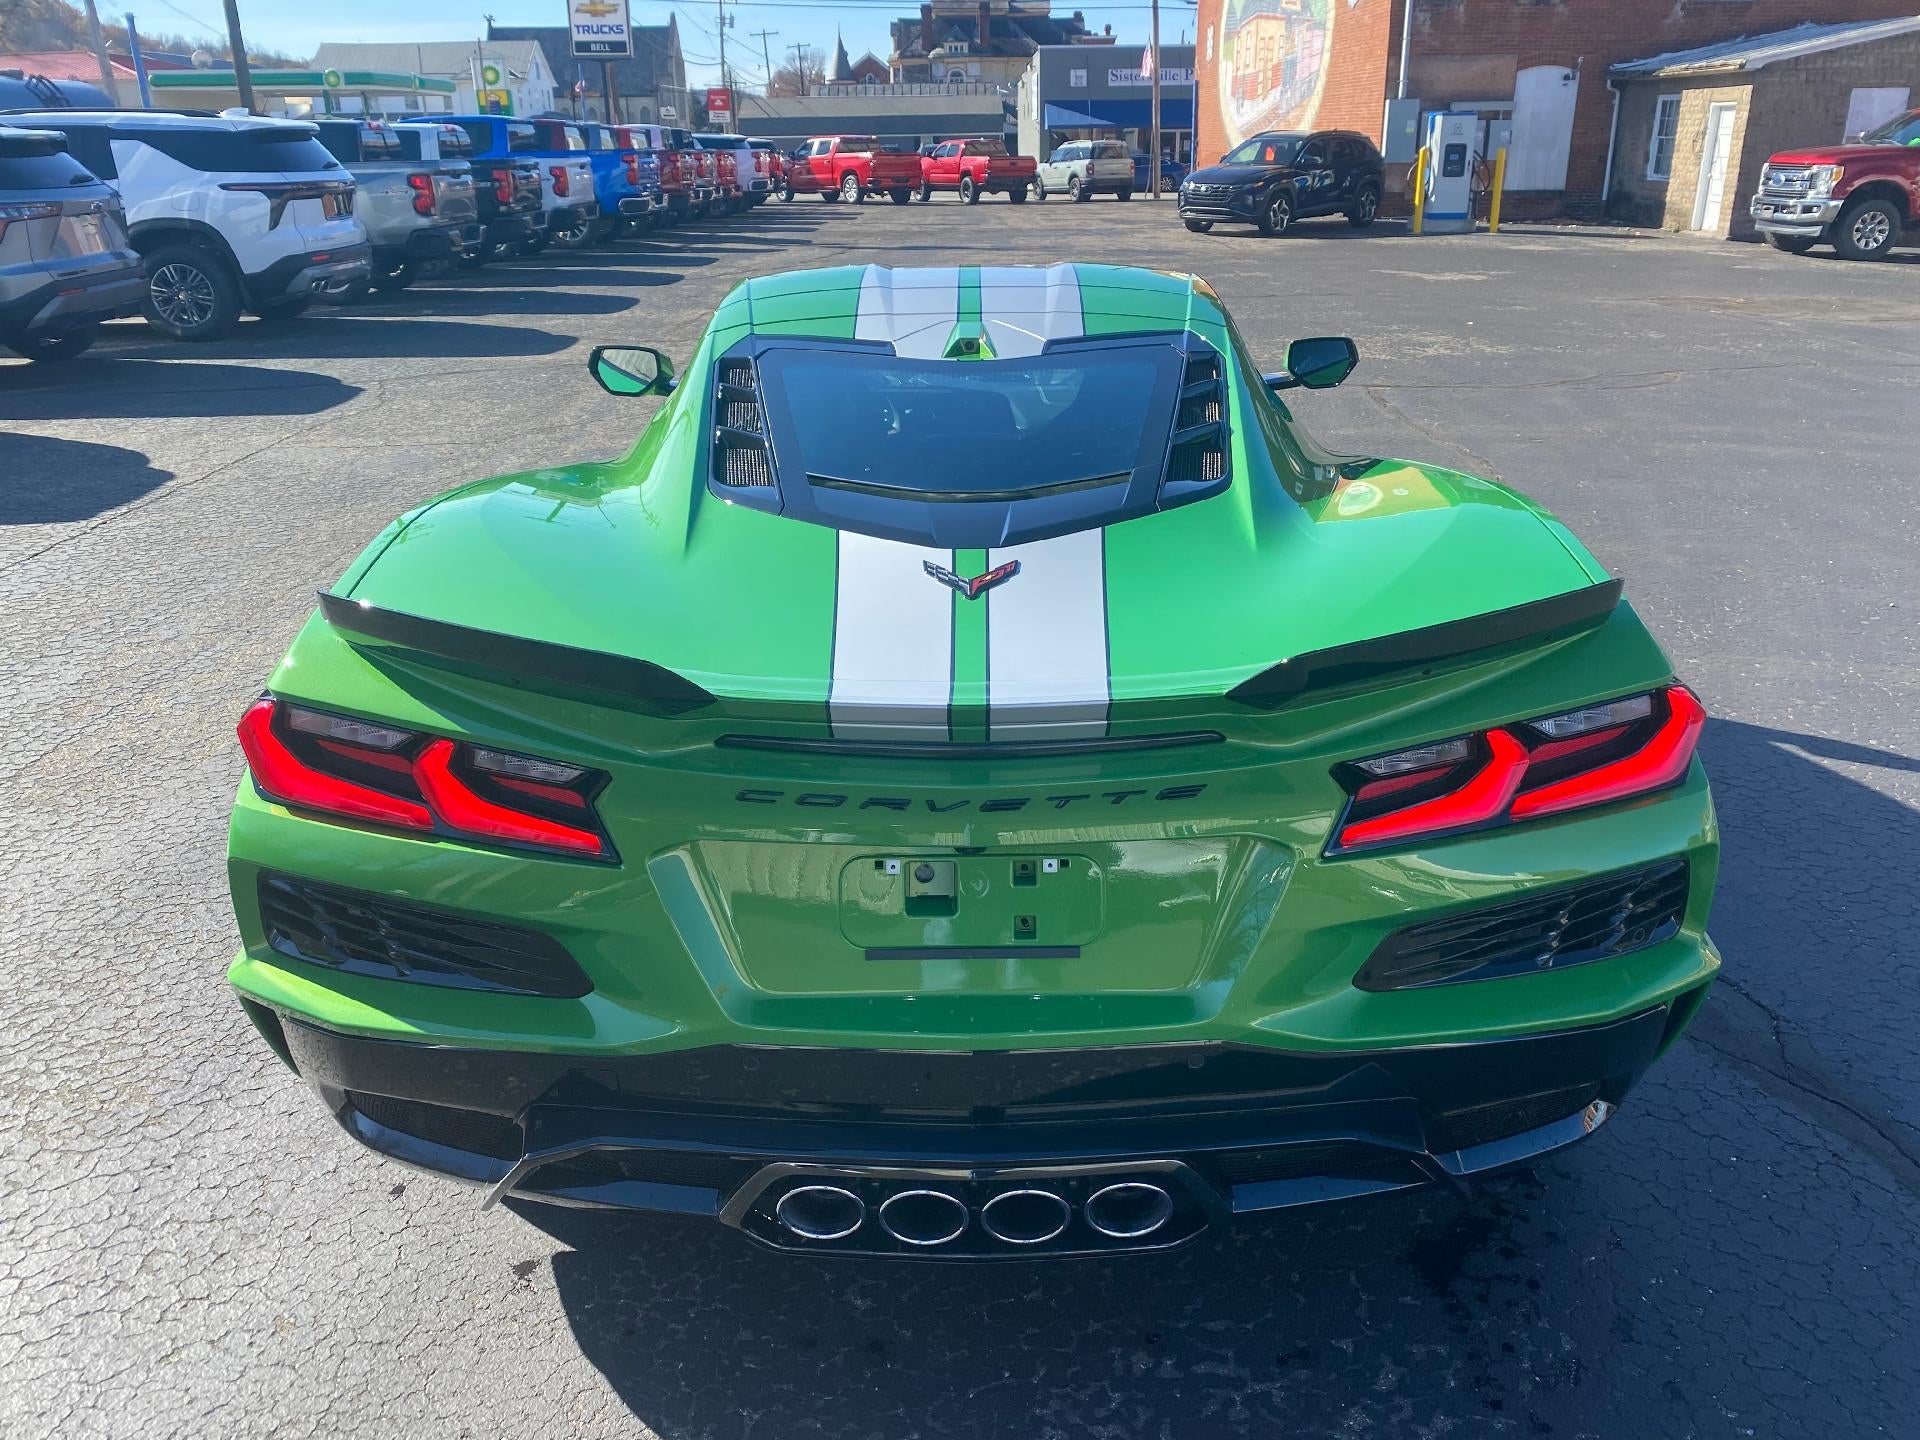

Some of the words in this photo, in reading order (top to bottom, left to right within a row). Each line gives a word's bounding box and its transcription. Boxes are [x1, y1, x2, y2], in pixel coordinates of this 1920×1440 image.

[574, 24, 624, 35] TRUCKS
[590, 43, 611, 51] BELL
[1110, 69, 1179, 81] Sistersille
[735, 783, 1208, 813] CORVETTE
